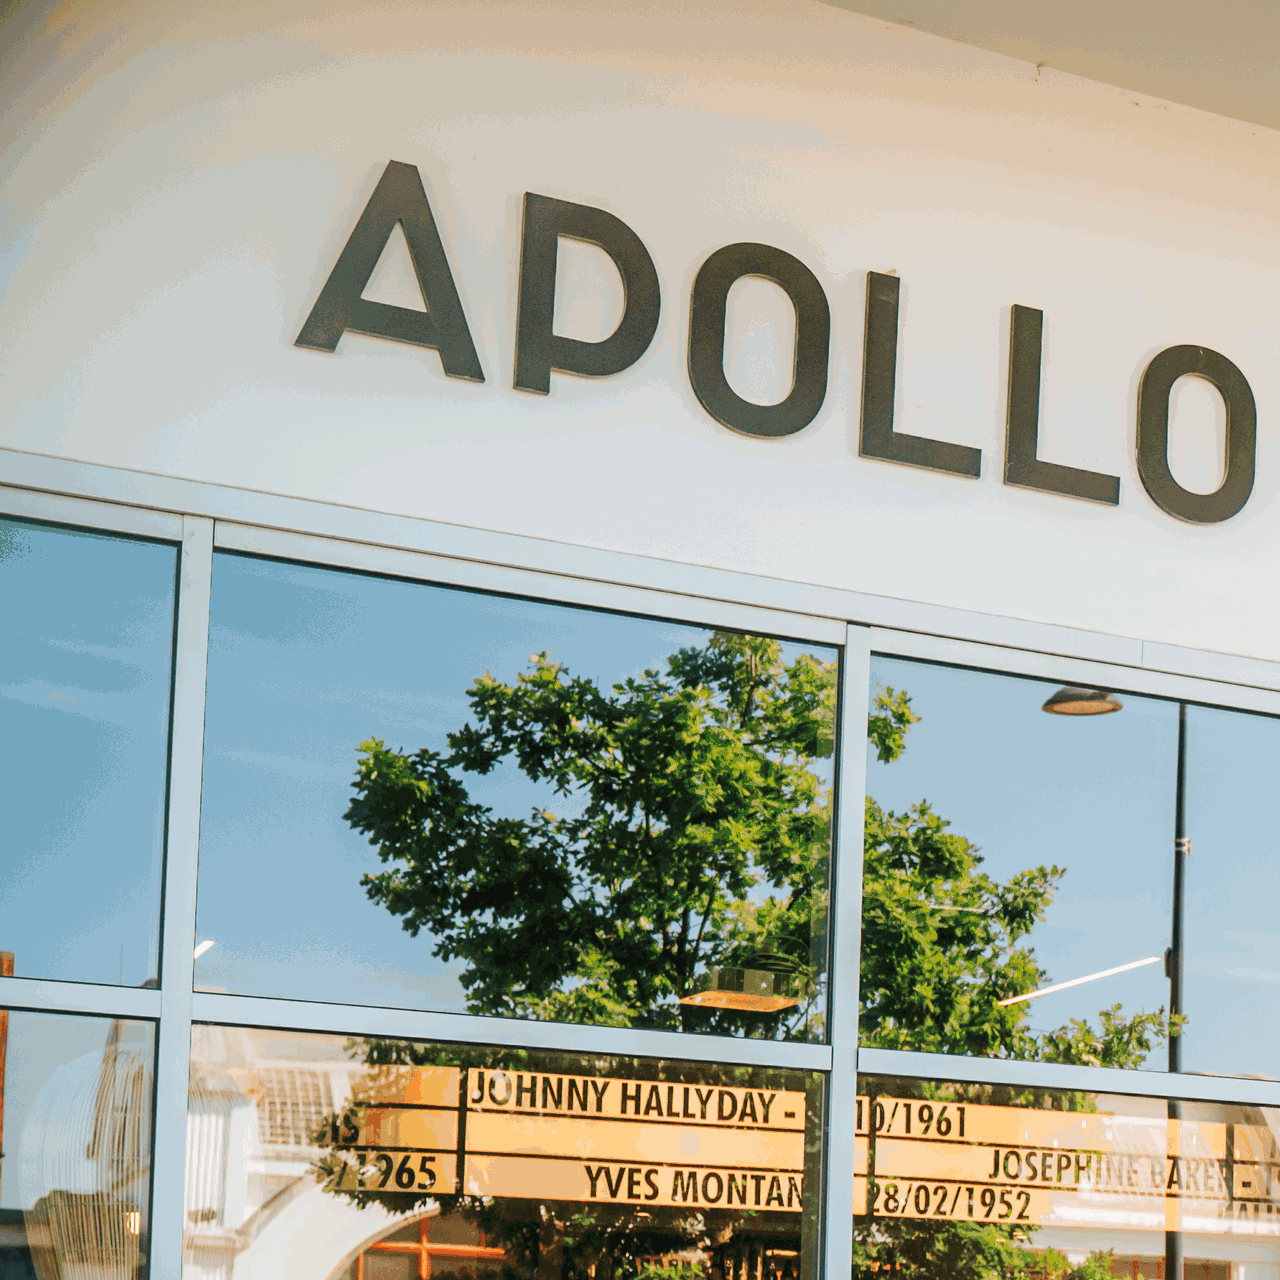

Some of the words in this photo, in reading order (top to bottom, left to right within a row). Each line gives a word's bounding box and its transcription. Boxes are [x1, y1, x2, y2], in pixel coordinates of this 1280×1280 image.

[294, 158, 1257, 525] APOLLO
[471, 1070, 611, 1112] JOHNNY
[620, 1082, 777, 1125] HALLYDAY
[584, 1165, 660, 1200] YVES
[873, 1182, 1032, 1221] 28/02/1952
